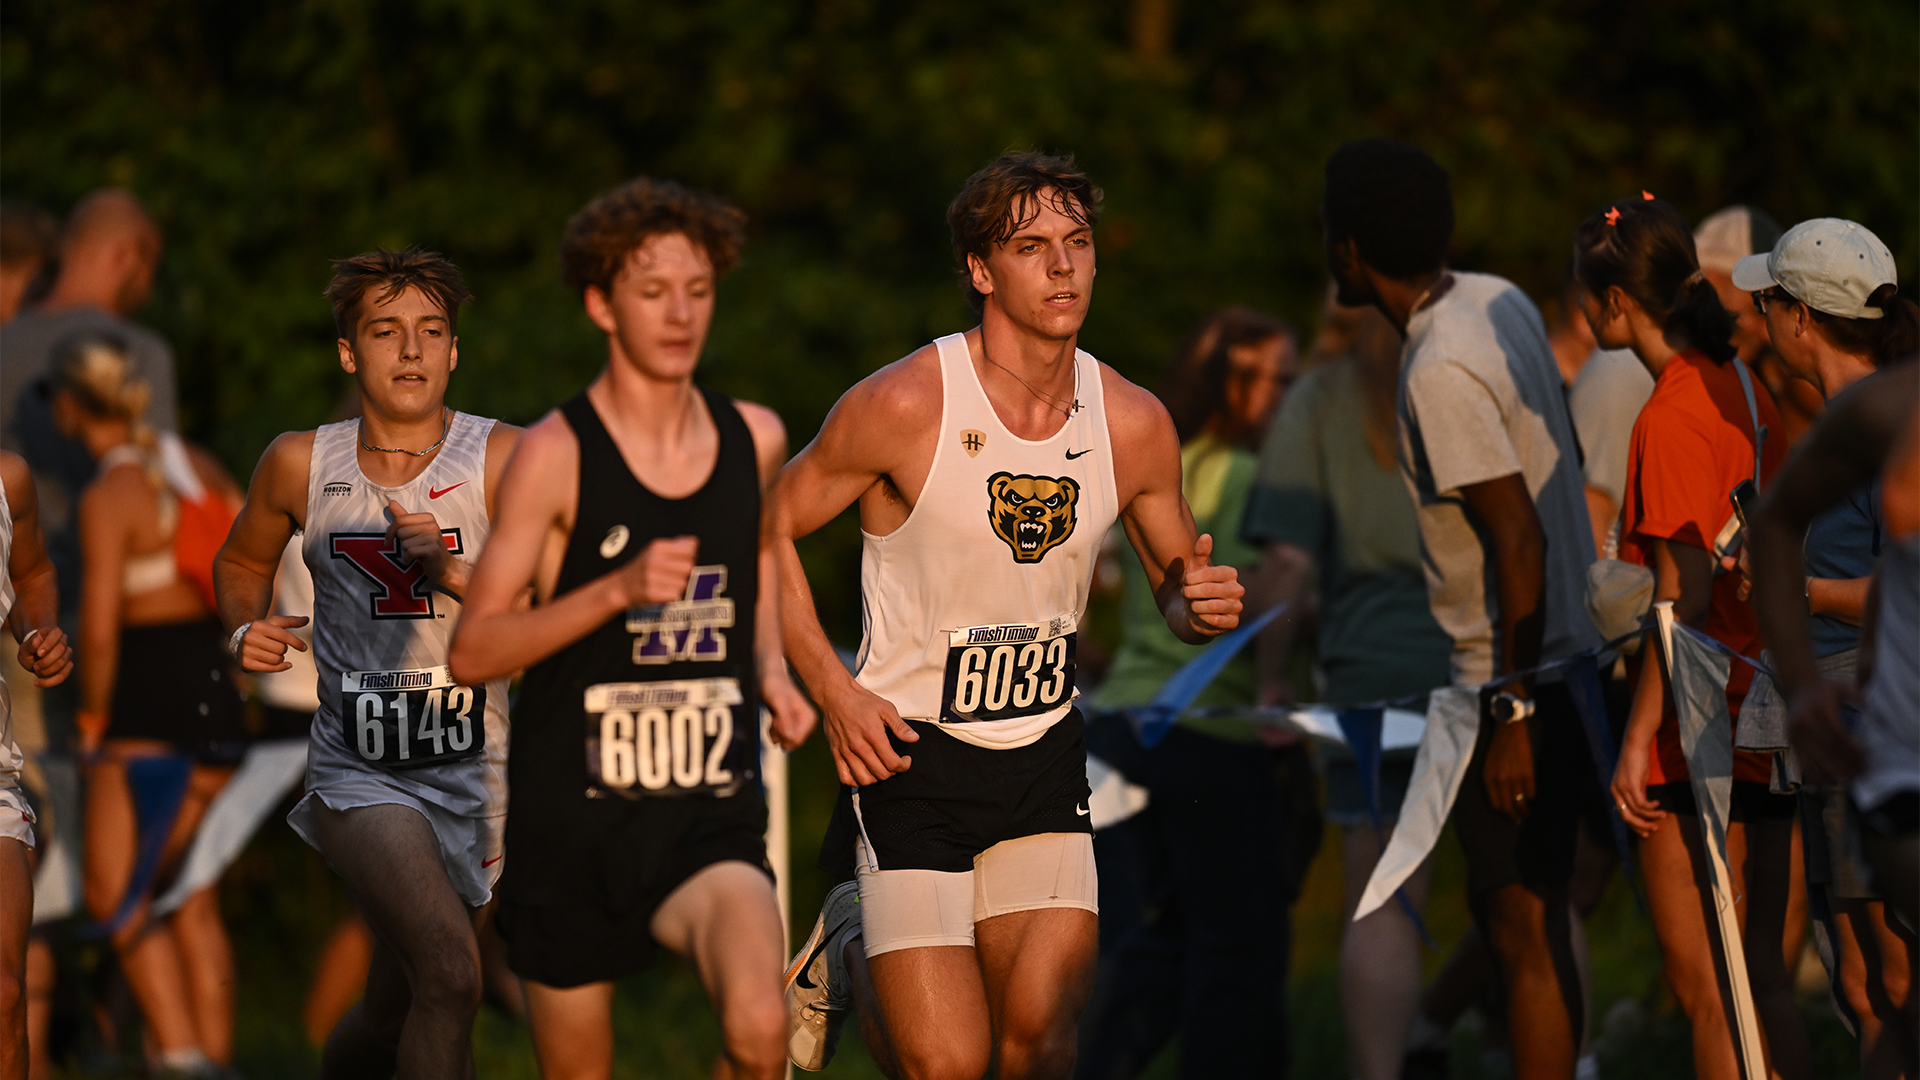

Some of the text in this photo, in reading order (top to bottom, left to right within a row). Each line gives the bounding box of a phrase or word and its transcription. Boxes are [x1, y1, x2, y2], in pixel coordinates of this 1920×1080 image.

[329, 527, 464, 620] Y
[966, 625, 1040, 644] FinishTiming
[359, 671, 433, 690] FinishTiming
[955, 637, 1067, 713] 6033
[356, 685, 474, 761] 6143
[600, 705, 734, 790] 6002
